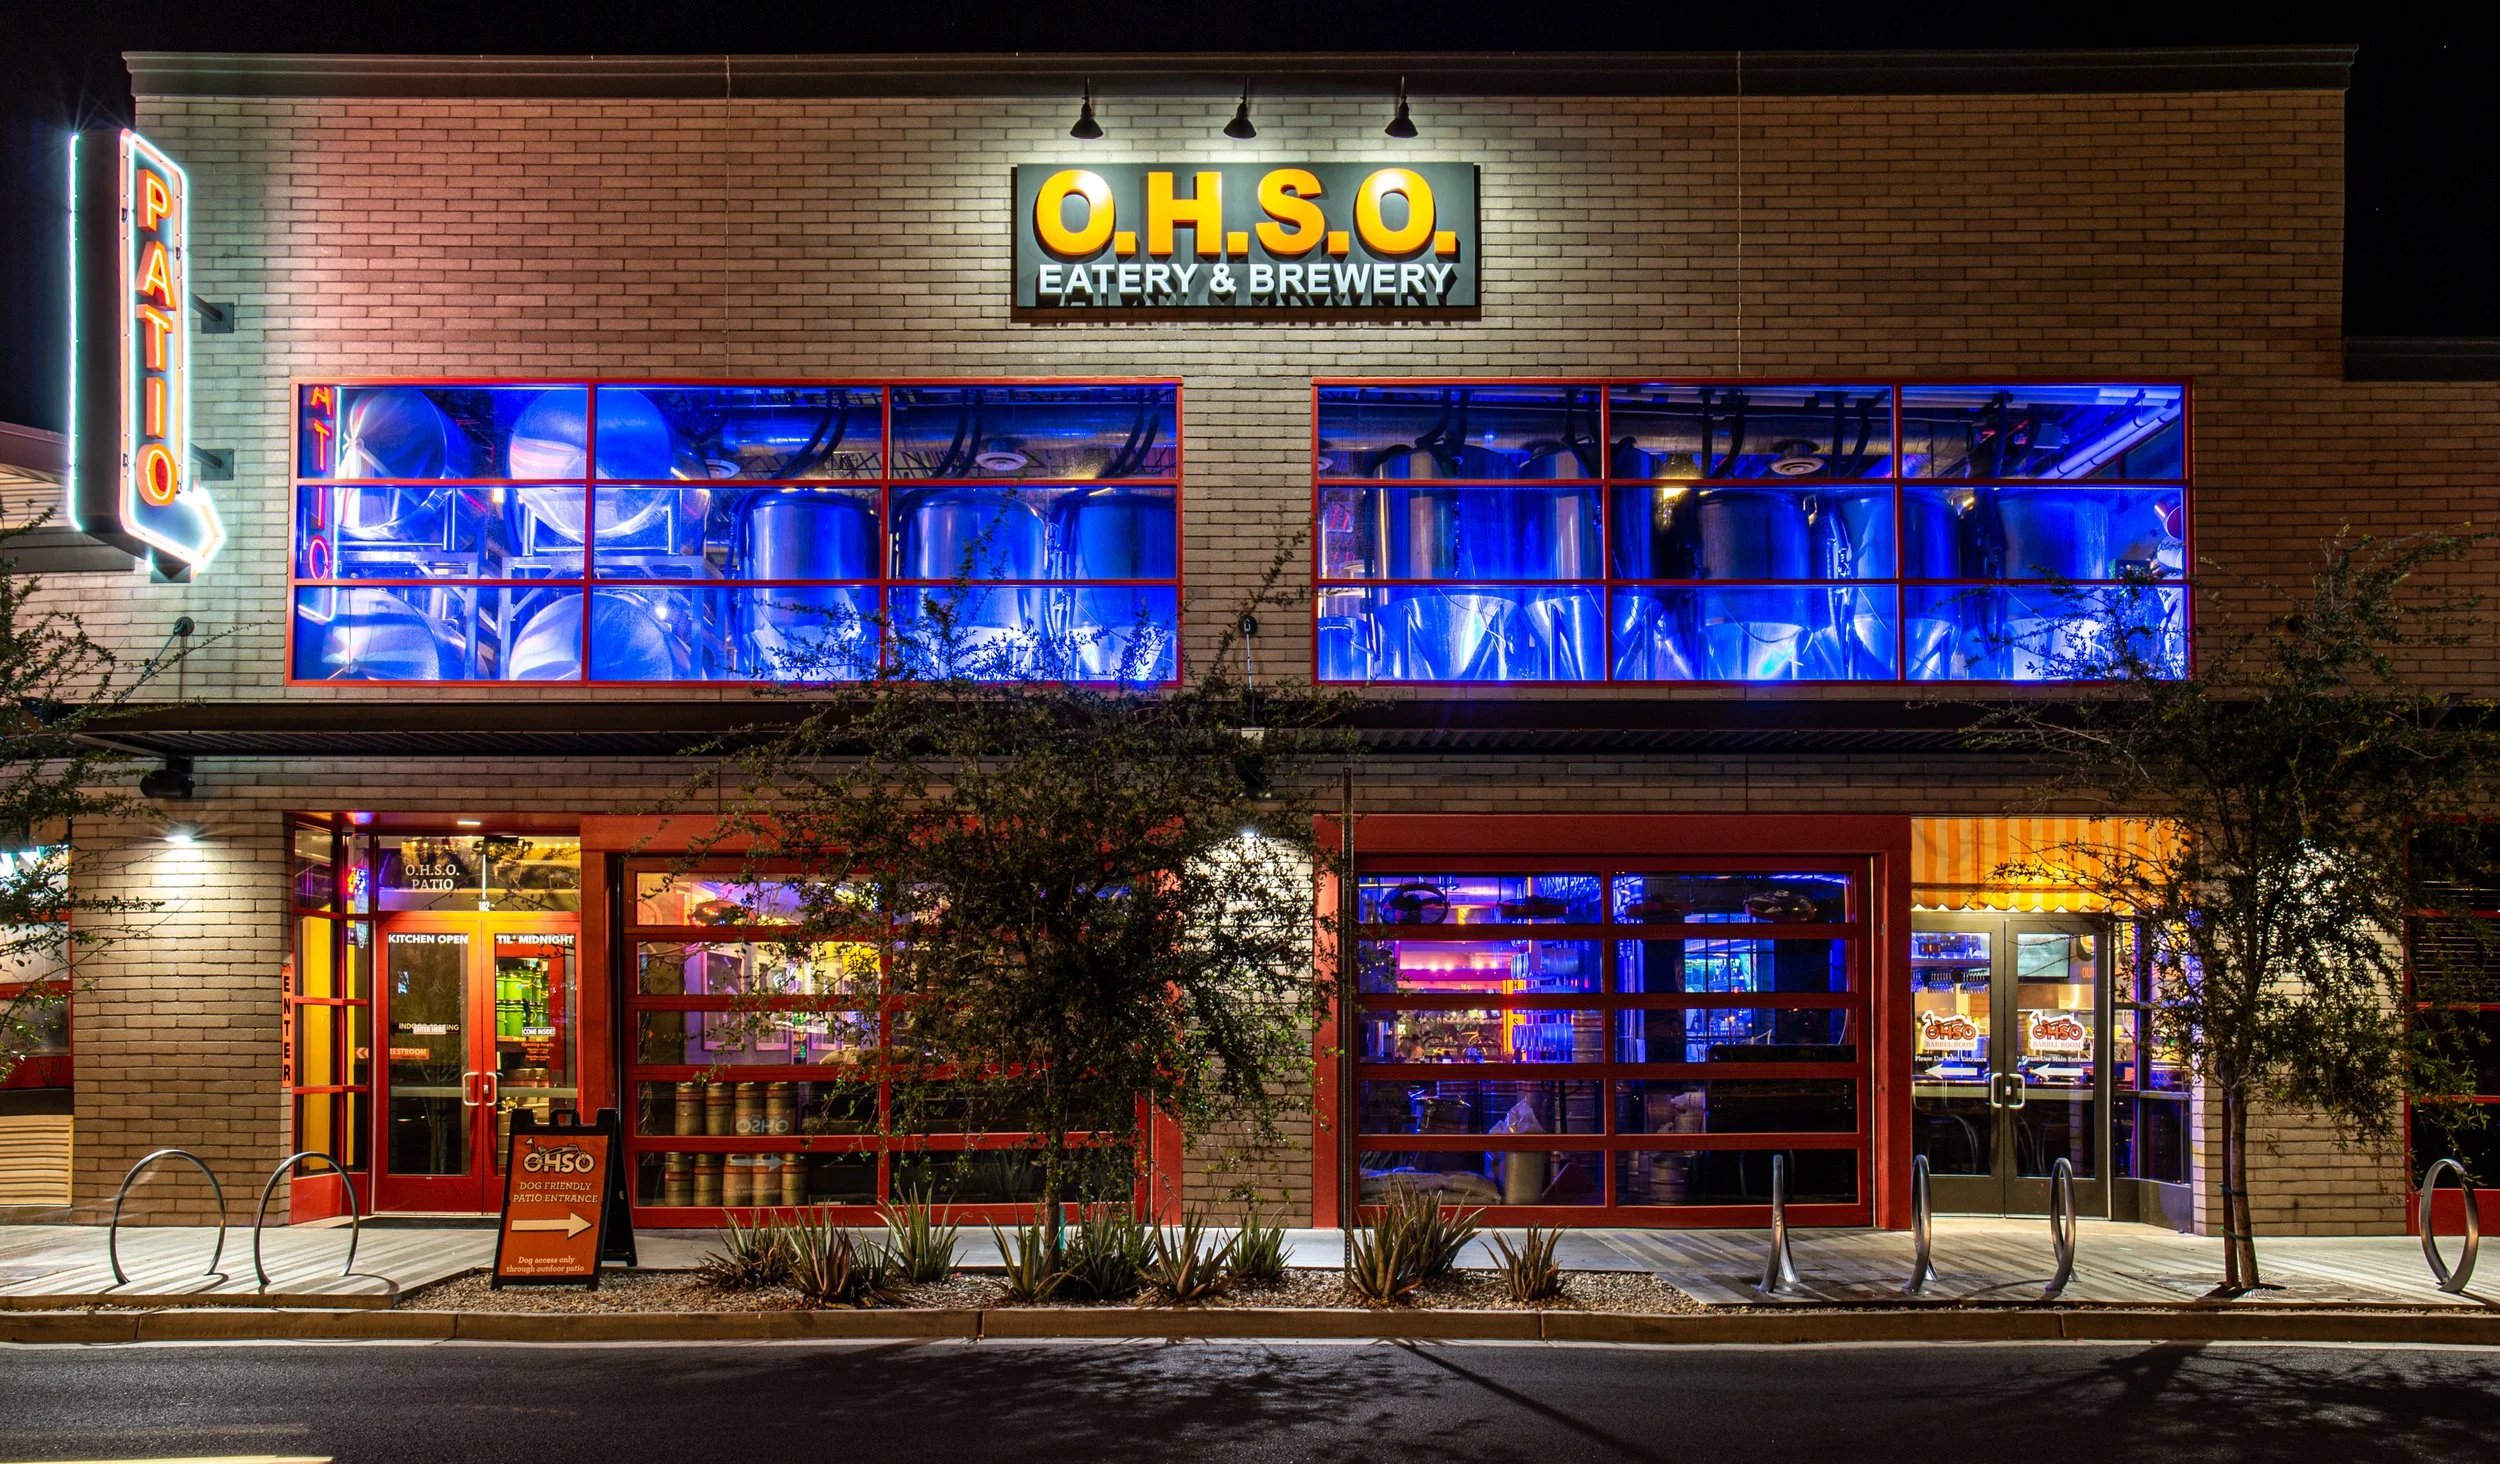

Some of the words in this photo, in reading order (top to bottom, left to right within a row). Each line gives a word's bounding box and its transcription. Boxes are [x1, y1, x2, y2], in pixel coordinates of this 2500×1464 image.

[1034, 168, 1457, 256] O.H.S.O.
[1039, 264, 1193, 296] EATERY
[1209, 263, 1238, 295] &
[1250, 264, 1454, 296] BREWERY
[136, 168, 177, 507] PATIO
[405, 864, 460, 876] O.H.S.O.
[412, 879, 454, 890] PATIO
[479, 901, 490, 911] 102
[388, 934, 434, 944] KITCHEN
[437, 935, 469, 944] OPEN
[519, 935, 575, 945] MIDNIGHT
[283, 976, 291, 1082] ENTER
[1925, 1023, 1977, 1041] OHSO
[2032, 1023, 2083, 1041] OHSO
[523, 1152, 595, 1173] OHSO
[520, 1182, 542, 1190] DOG
[544, 1182, 592, 1191] FRIENDLY
[513, 1194, 542, 1203] PATIO
[545, 1194, 598, 1203] ENTRANCE
[518, 1257, 533, 1265] Dog
[559, 1256, 575, 1265] only
[506, 1265, 535, 1274] through
[566, 1266, 585, 1274] patio
